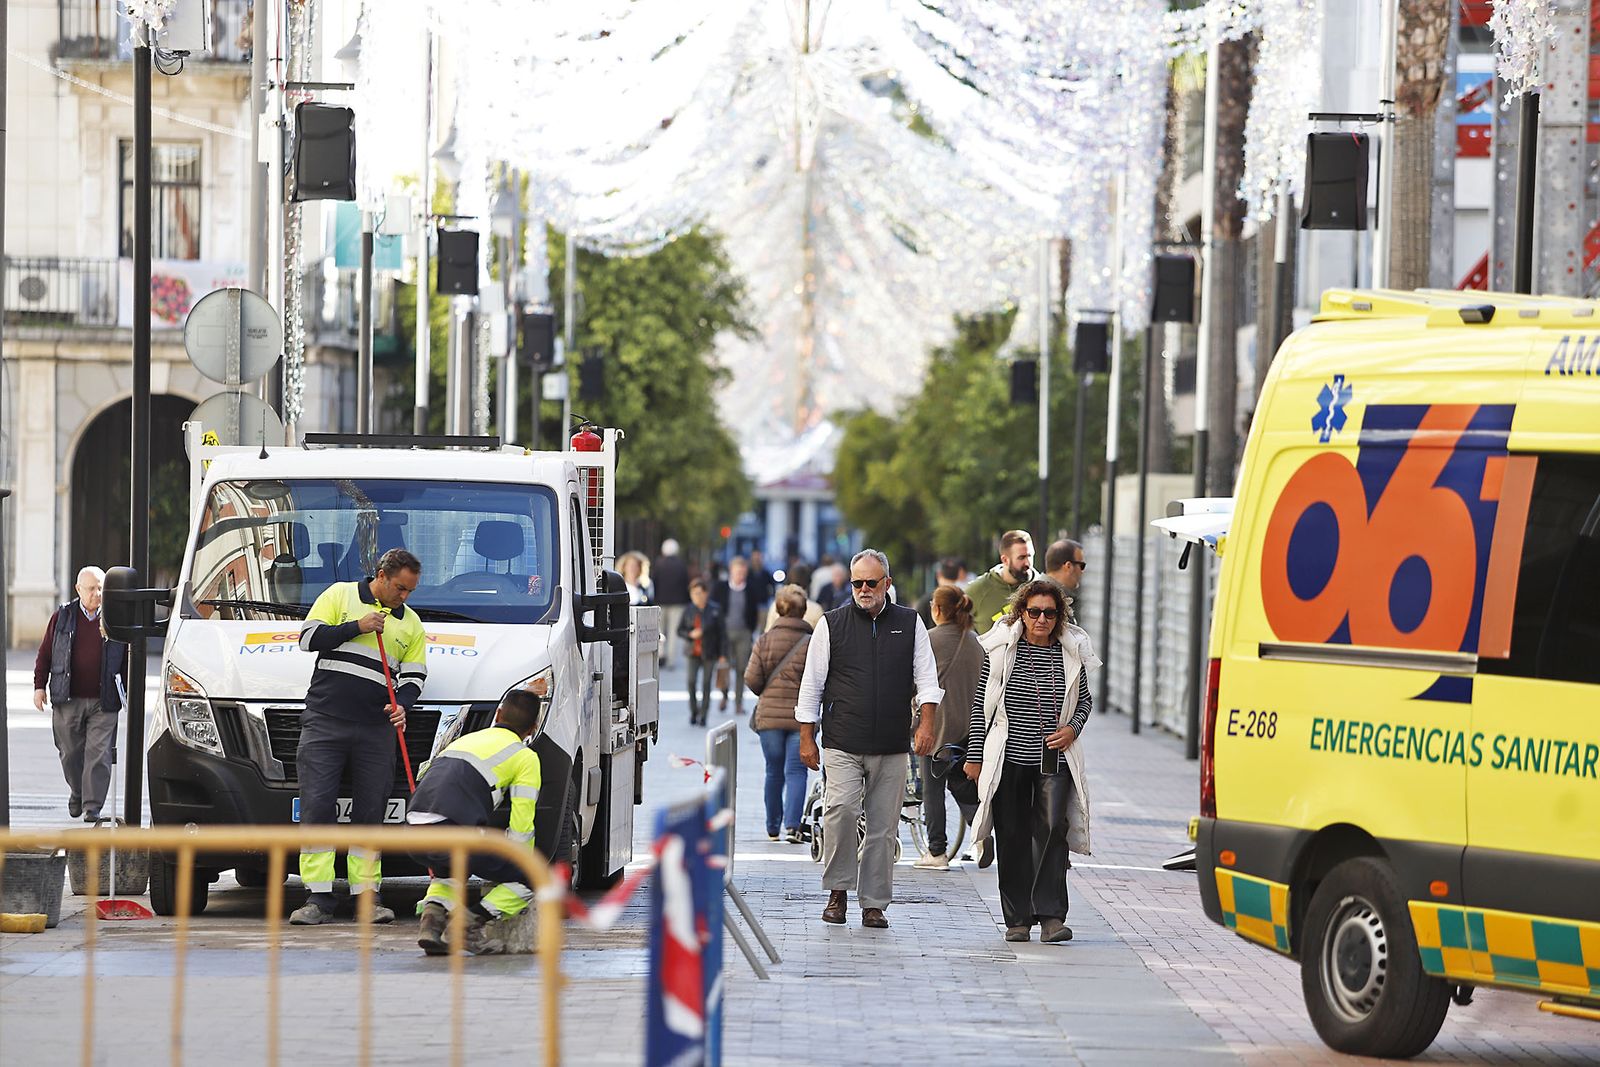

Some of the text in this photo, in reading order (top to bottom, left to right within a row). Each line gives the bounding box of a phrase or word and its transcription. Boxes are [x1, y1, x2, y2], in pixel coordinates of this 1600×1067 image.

[1544, 335, 1600, 376] AM
[1260, 404, 1538, 659] 061
[1227, 709, 1278, 739] E-268
[1310, 717, 1600, 779] EMERGENCIAS SANITAR
